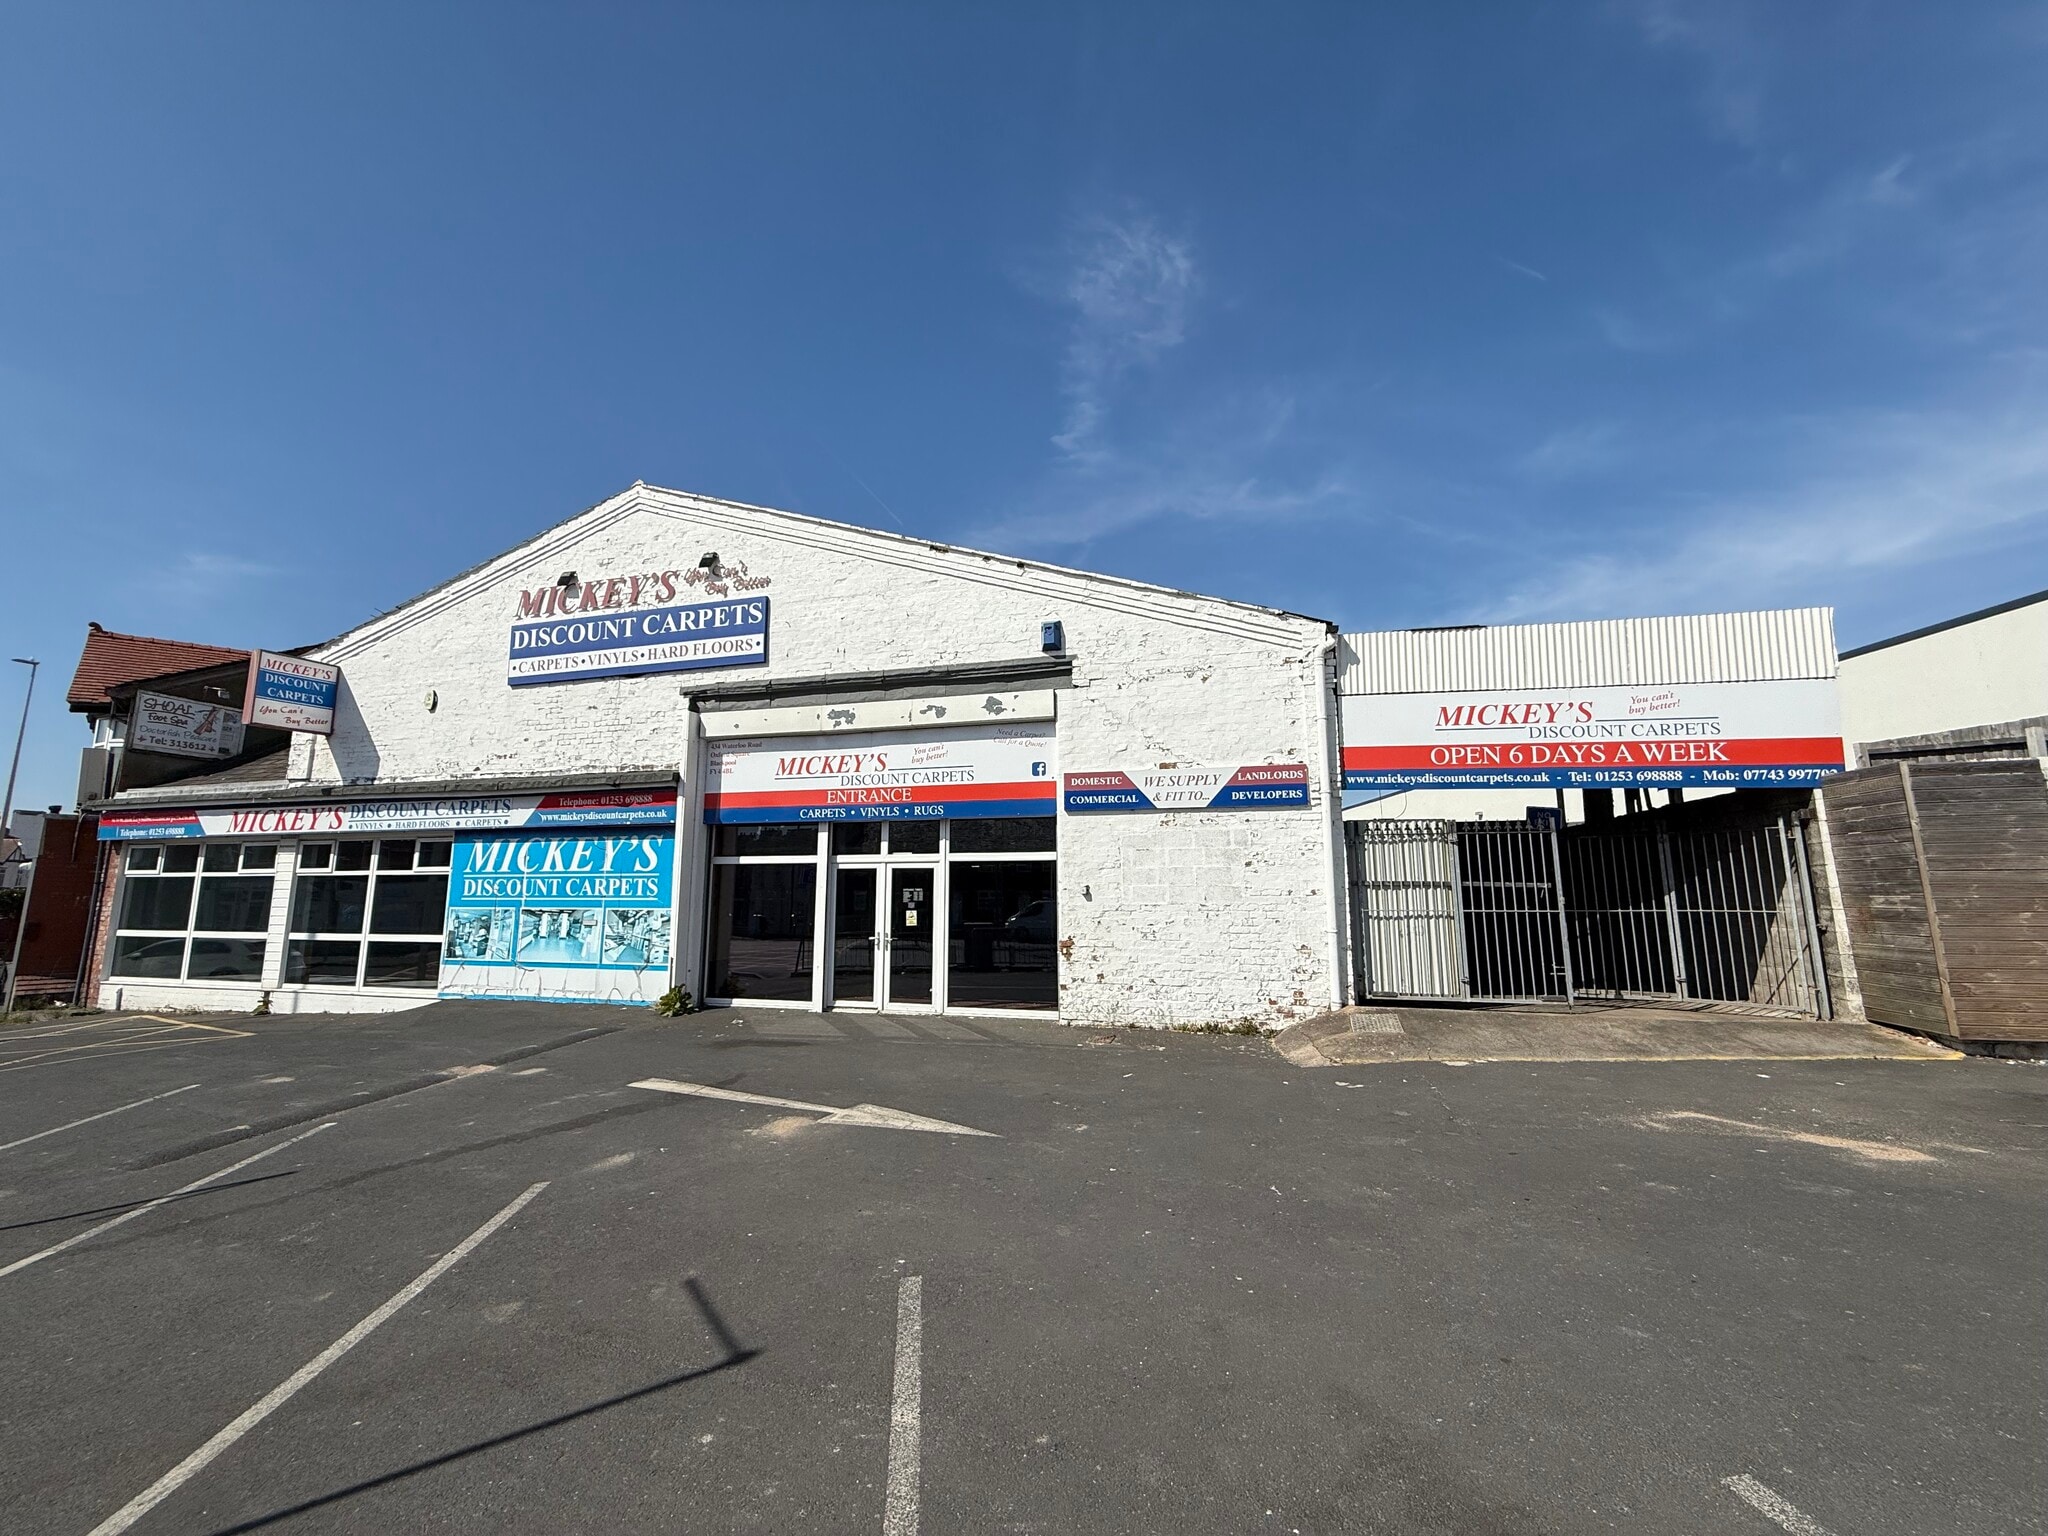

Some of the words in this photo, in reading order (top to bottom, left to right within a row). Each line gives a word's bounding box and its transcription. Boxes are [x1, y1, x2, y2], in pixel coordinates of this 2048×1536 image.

[514, 570, 679, 619] MICKEY'S
[513, 617, 637, 650] DISCOUNT
[642, 602, 763, 635] CARPETS
[519, 656, 579, 674] CARPETS
[588, 650, 639, 666] VINYLS
[647, 643, 689, 660] HARD
[694, 638, 754, 656] FLOORS
[265, 659, 333, 680] MICKEY'S
[265, 673, 329, 692] DISCOUNT
[267, 687, 324, 704] CARPETS
[1631, 695, 1648, 704] You
[1651, 690, 1674, 702] can't
[260, 705, 278, 715] You
[1435, 701, 1593, 726] MICKEY'S
[1628, 704, 1646, 715] buy
[1649, 699, 1681, 711] better!
[148, 712, 168, 723] Foot
[170, 716, 188, 725] Spa
[283, 716, 301, 726] Buy
[303, 717, 328, 725] Better
[1529, 724, 1626, 739] DISCOUNT
[1631, 722, 1721, 737] CARPETS
[149, 736, 167, 746] Tel:
[169, 739, 206, 751] 313612
[913, 747, 926, 755] You
[911, 756, 924, 765] buy
[1430, 747, 1501, 766] OPEN
[1509, 747, 1523, 764] 6
[1531, 744, 1606, 764] DAYS
[1613, 745, 1634, 763] A
[1639, 741, 1730, 763] WEEK
[775, 752, 888, 776] MICKEY'S
[840, 772, 909, 787] DISCOUNT
[912, 769, 975, 784] CARPETS
[1071, 776, 1122, 786] DOMESTIC
[1144, 776, 1166, 787] WE
[1167, 773, 1222, 787] SUPPLY
[1237, 770, 1304, 781] LANDLORDS
[1347, 773, 1550, 786] www.mickeysdiscountcarpets.co.uk
[1568, 772, 1591, 783] Tel:
[1595, 772, 1633, 783] 01253
[1636, 771, 1683, 782] 698888
[1703, 769, 1739, 782] Mob:
[1743, 769, 1785, 781] 07743
[559, 798, 599, 807] Telephone:
[600, 796, 624, 805] 01253
[826, 788, 912, 804] ENTRANCE
[1069, 794, 1139, 804] COMMERCIAL
[1152, 792, 1162, 801] &
[1165, 792, 1185, 801] FIT
[1231, 789, 1303, 800] DEVELOPERS
[350, 802, 432, 819] DISCOUNT
[434, 799, 512, 815] CARPETS
[540, 809, 668, 822] www.mickeysdiscountcarpets.co.uk
[800, 807, 846, 818] CARPETS
[860, 806, 900, 817] VINYLS
[914, 805, 944, 816] RUGS
[226, 806, 346, 833] MICKEY'S
[355, 822, 383, 830] VINYLS
[395, 821, 417, 829] HARD
[418, 820, 450, 828] FLOORS
[464, 818, 502, 827] CARPETS
[464, 834, 664, 873] MICKEY'S
[463, 878, 562, 897] DISCOUNT
[565, 877, 659, 896] CARPETS
